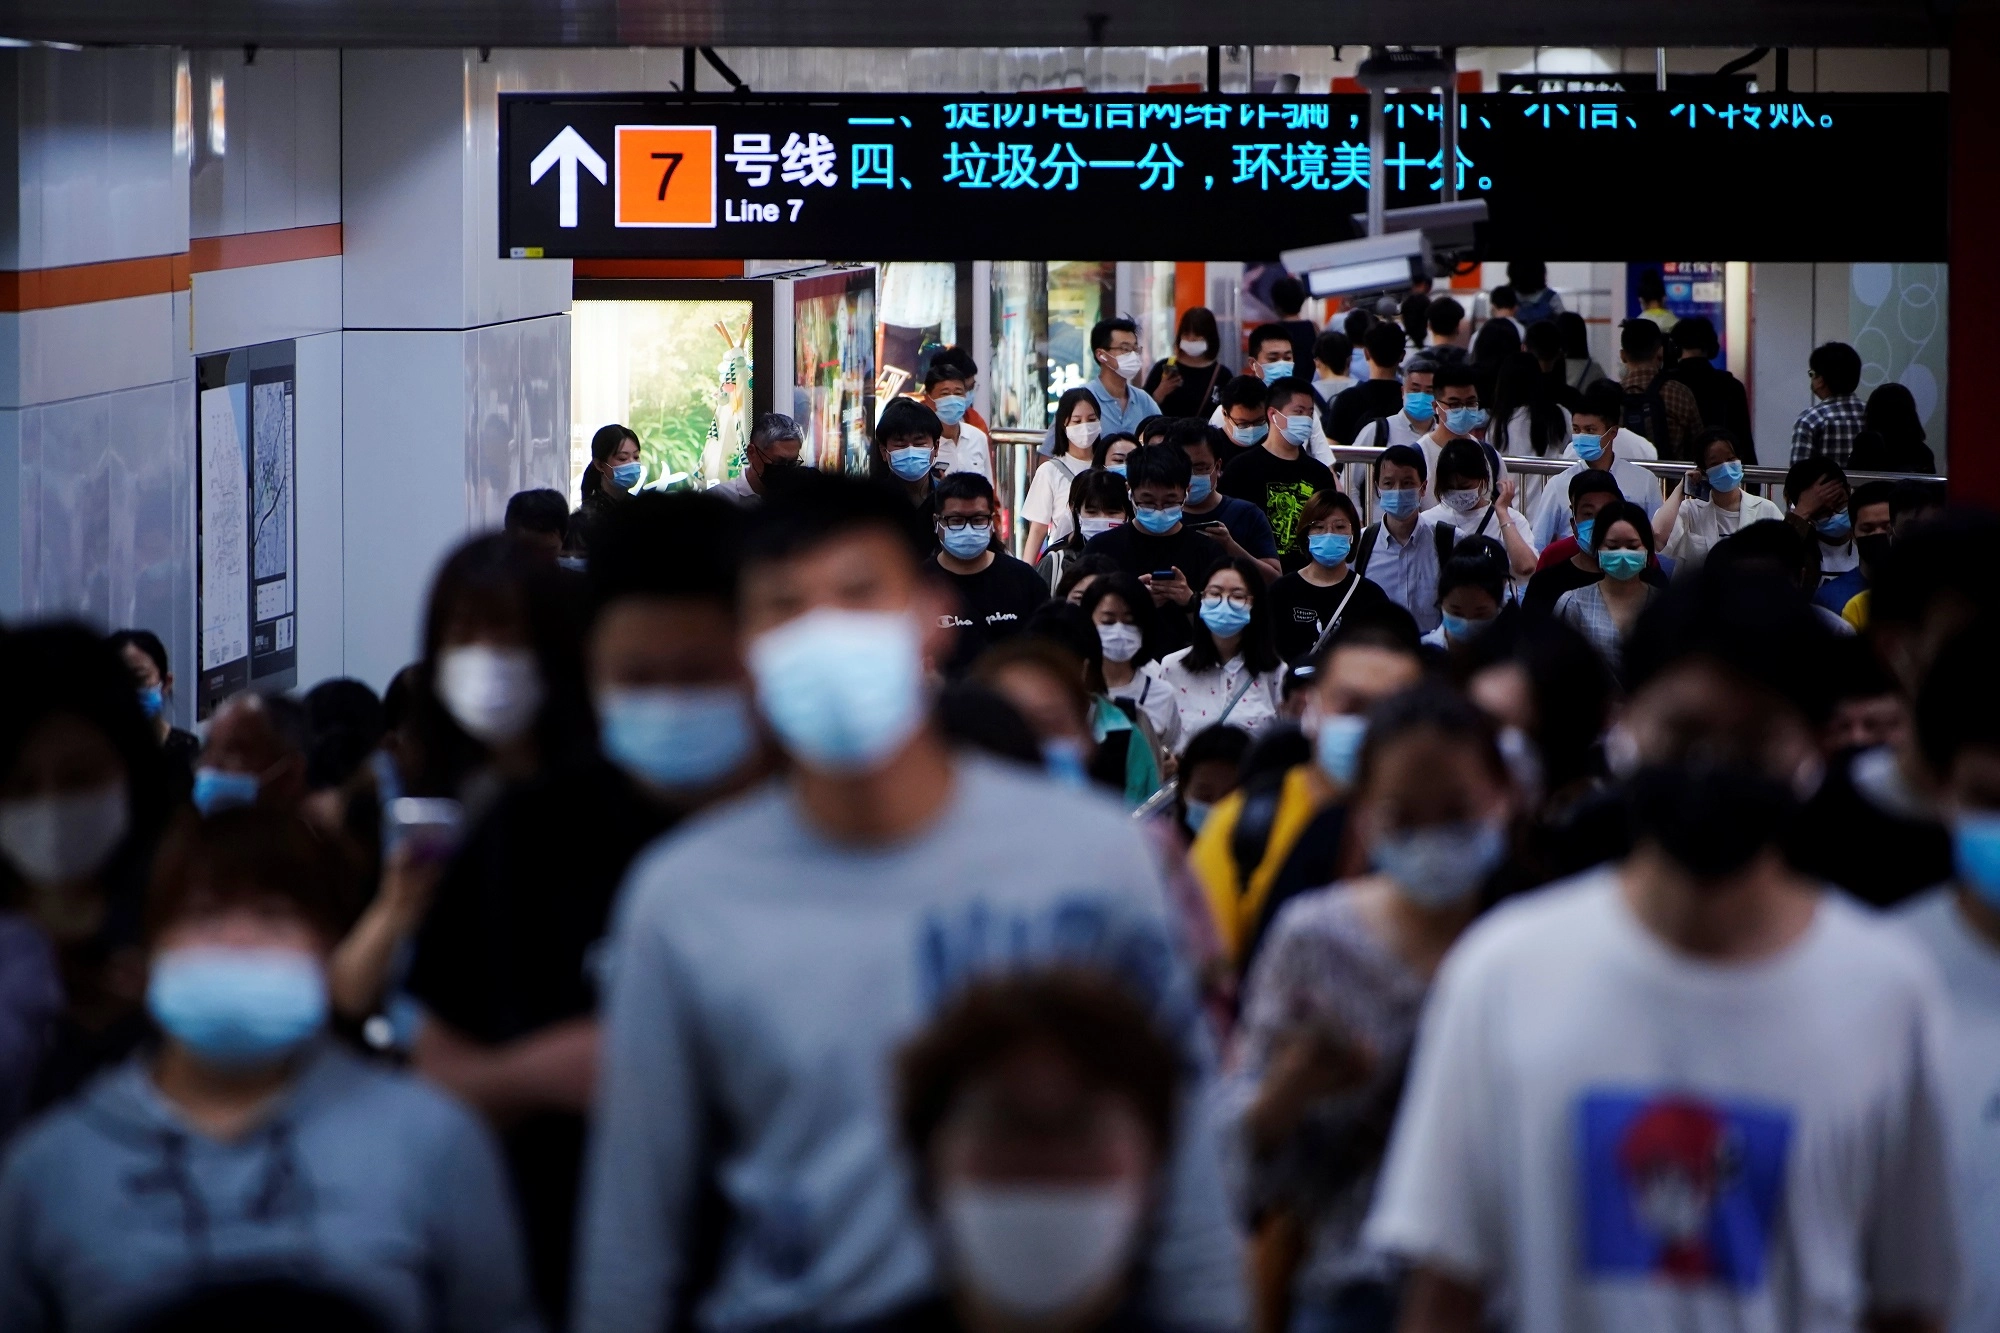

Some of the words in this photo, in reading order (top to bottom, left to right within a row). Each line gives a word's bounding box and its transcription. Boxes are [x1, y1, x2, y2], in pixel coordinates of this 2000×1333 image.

[651, 152, 683, 201] 7
[725, 133, 838, 187] 号线
[725, 199, 780, 223] Line
[787, 199, 804, 223] 7
